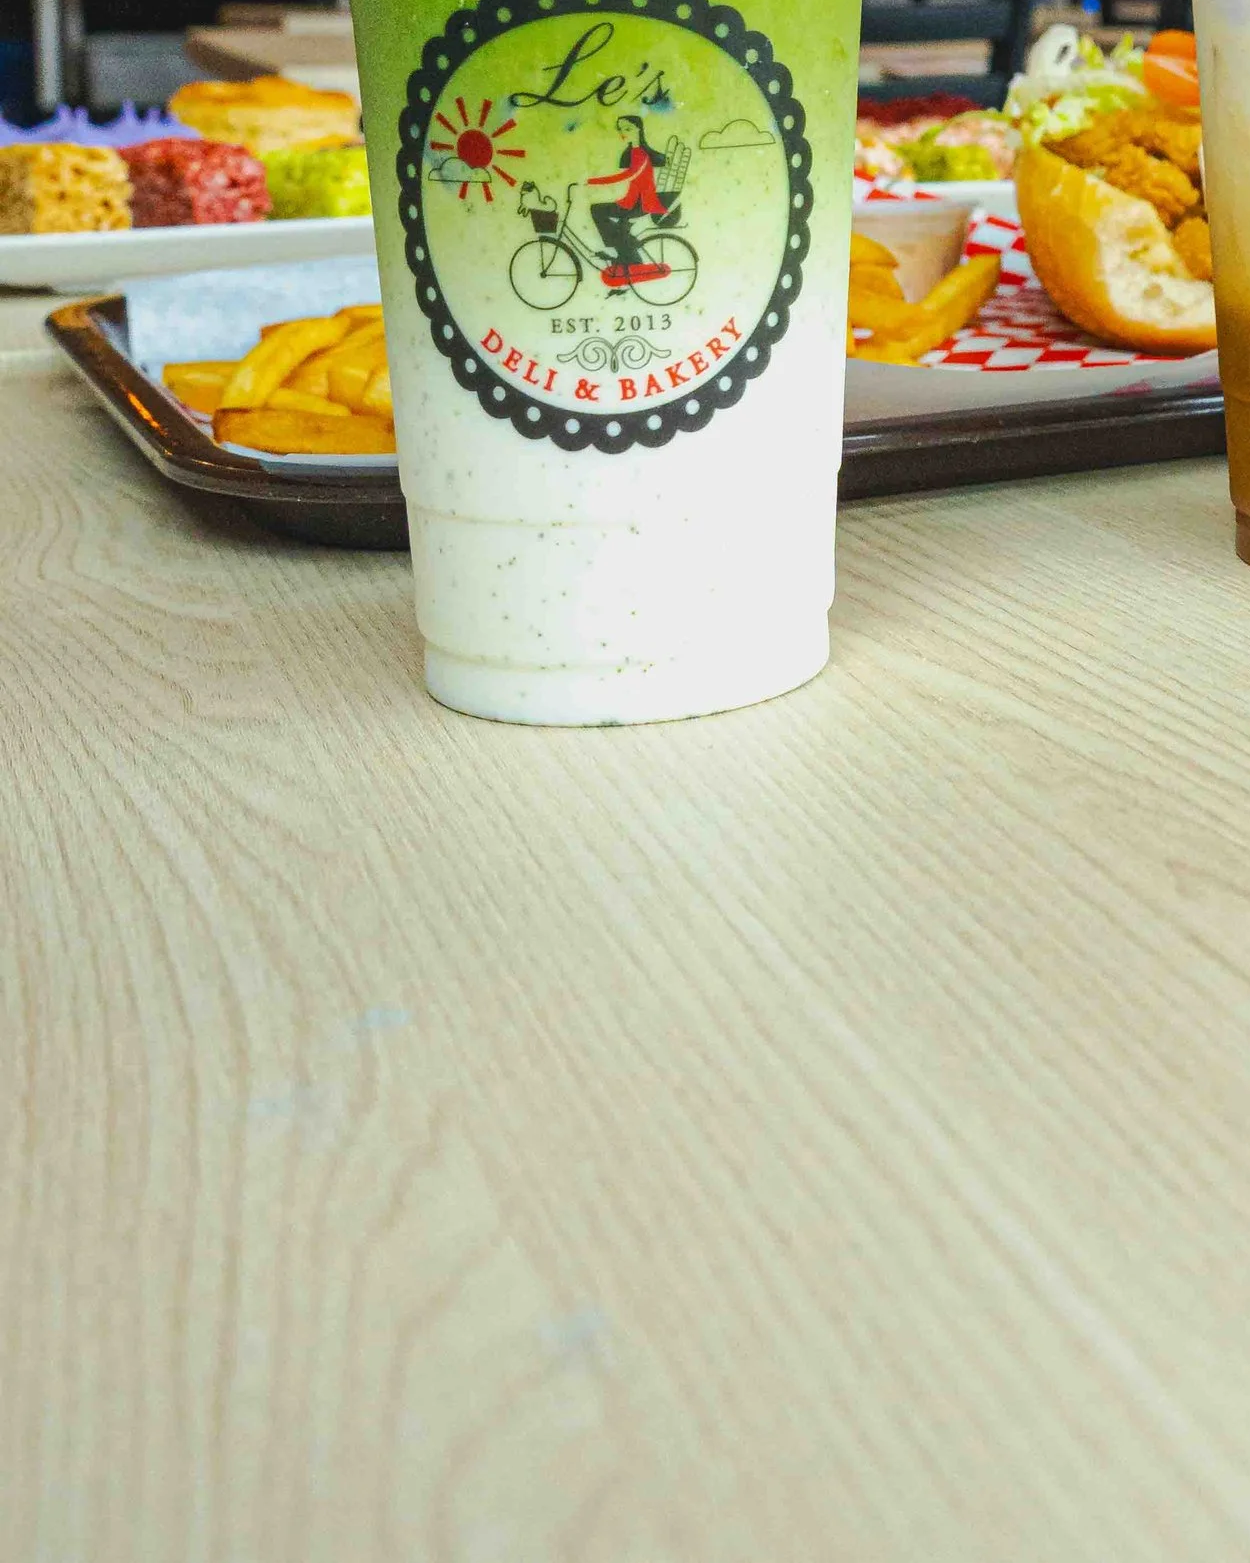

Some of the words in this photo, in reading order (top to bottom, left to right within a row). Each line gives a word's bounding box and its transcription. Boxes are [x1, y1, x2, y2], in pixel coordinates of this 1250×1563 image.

[508, 22, 671, 108] Le's
[480, 327, 554, 394] DELI
[575, 378, 600, 402] &
[619, 316, 743, 401] BAKERY
[551, 317, 600, 334] EST.
[614, 314, 673, 333] 2013
